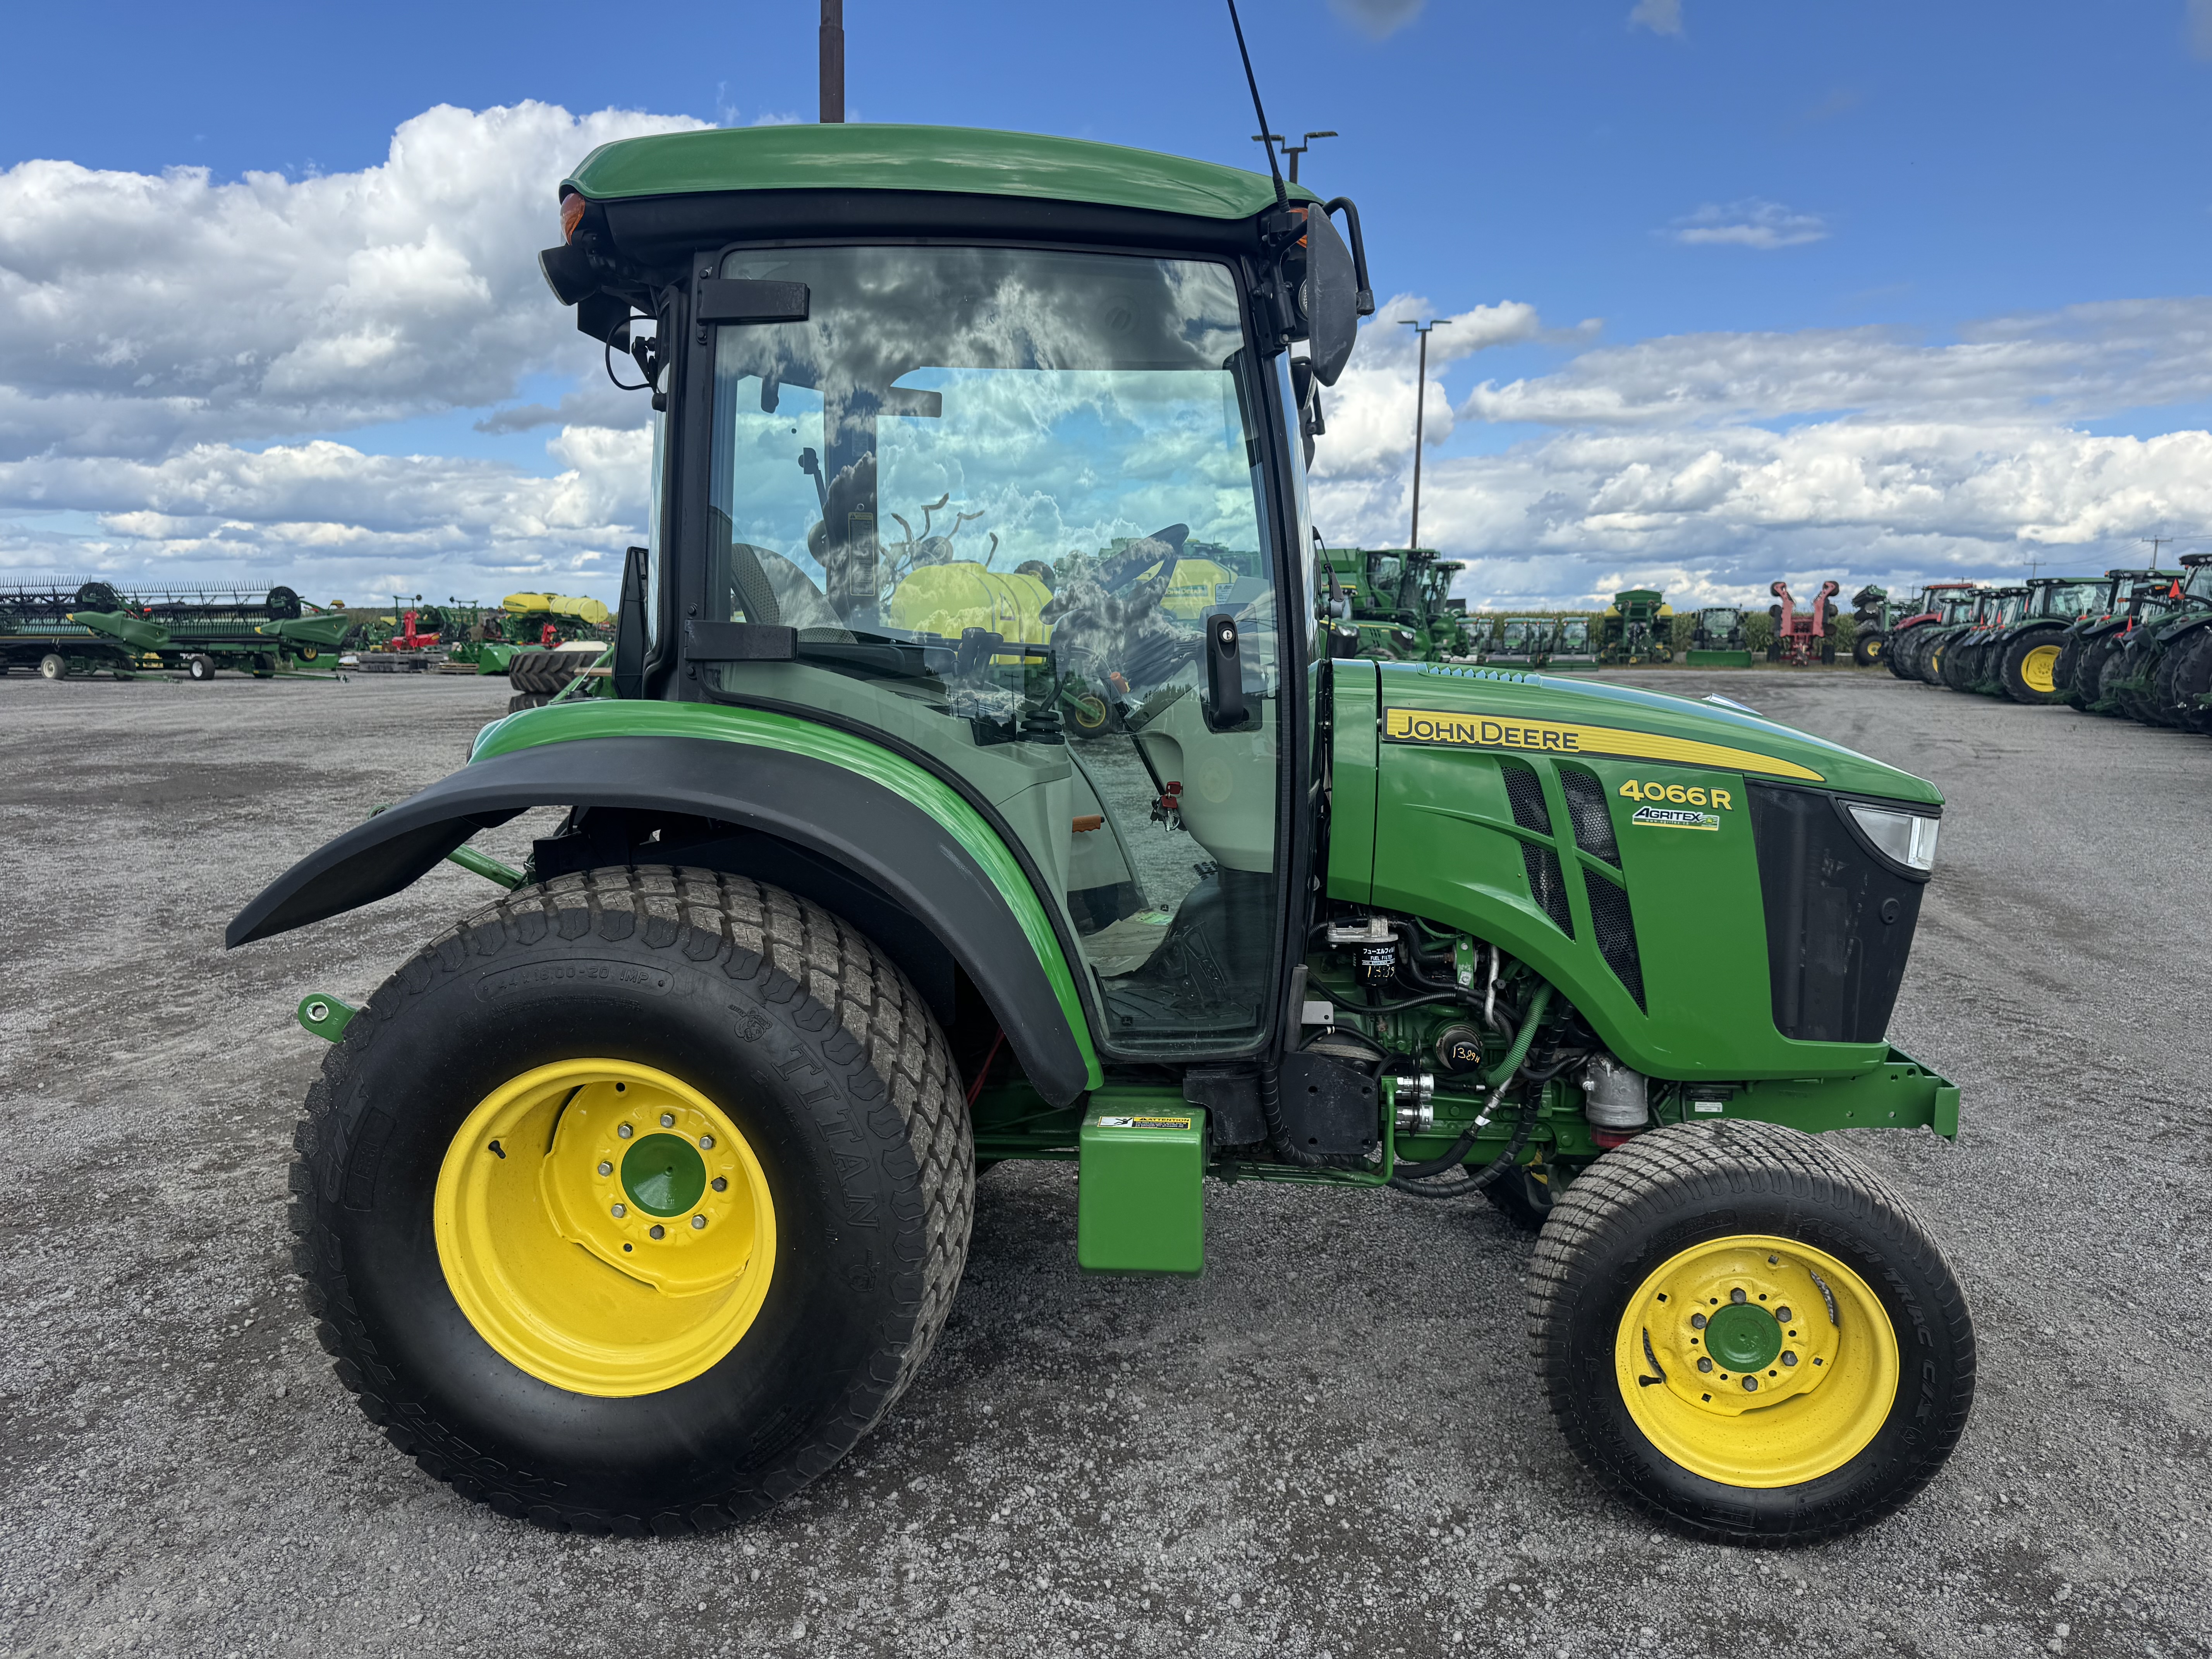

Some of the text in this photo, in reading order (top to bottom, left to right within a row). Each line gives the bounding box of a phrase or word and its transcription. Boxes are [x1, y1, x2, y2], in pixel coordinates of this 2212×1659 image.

[1397, 716, 1580, 750] JOHN DEERE
[1635, 808, 1701, 822] AGRITEX
[620, 969, 649, 984] IMP
[771, 1042, 881, 1233] TITAN
[1882, 1267, 1934, 1348] TRAC
[1587, 1395, 1651, 1481] TITAN
